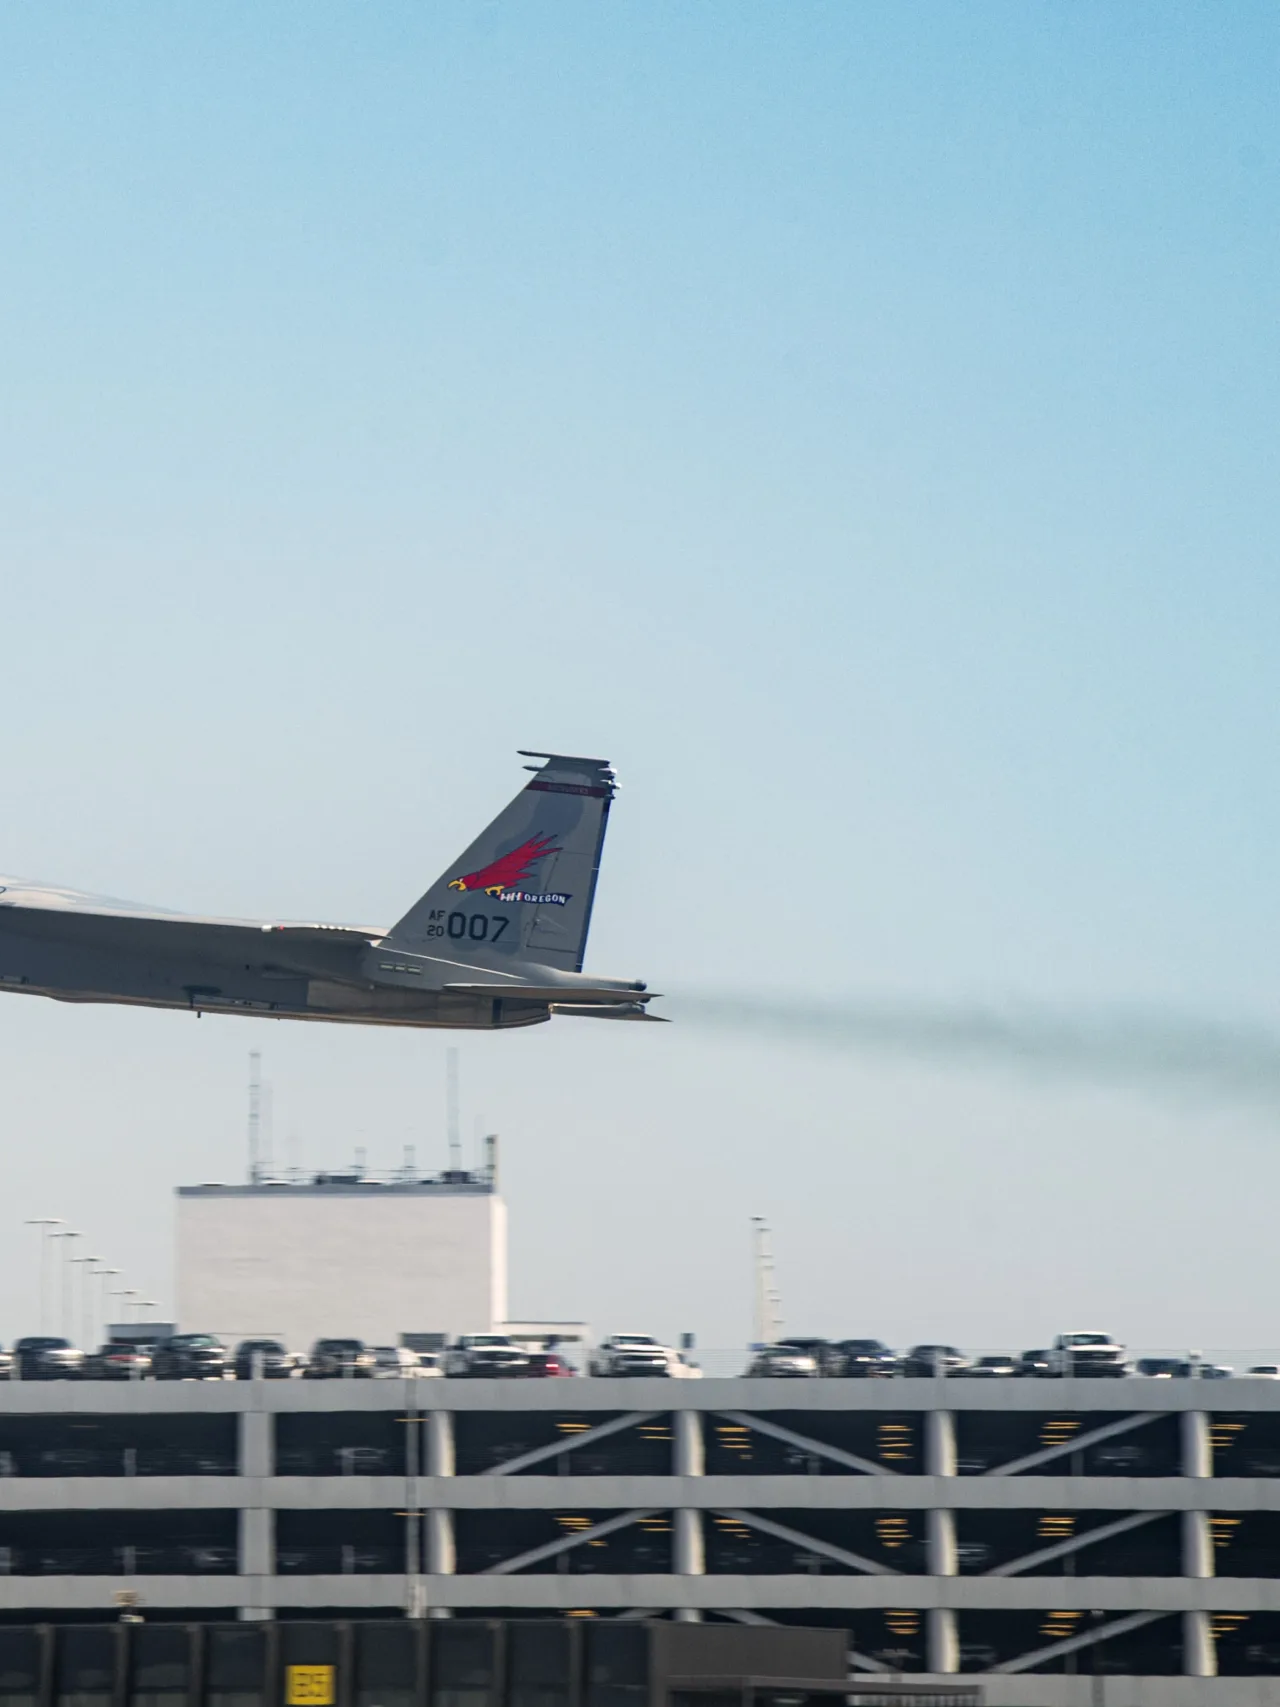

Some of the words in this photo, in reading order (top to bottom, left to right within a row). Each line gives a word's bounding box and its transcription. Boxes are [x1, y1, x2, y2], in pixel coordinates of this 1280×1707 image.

[524, 893, 566, 904] OREGON
[428, 909, 446, 921] AF
[427, 924, 445, 937] 20
[447, 911, 510, 942] 007
